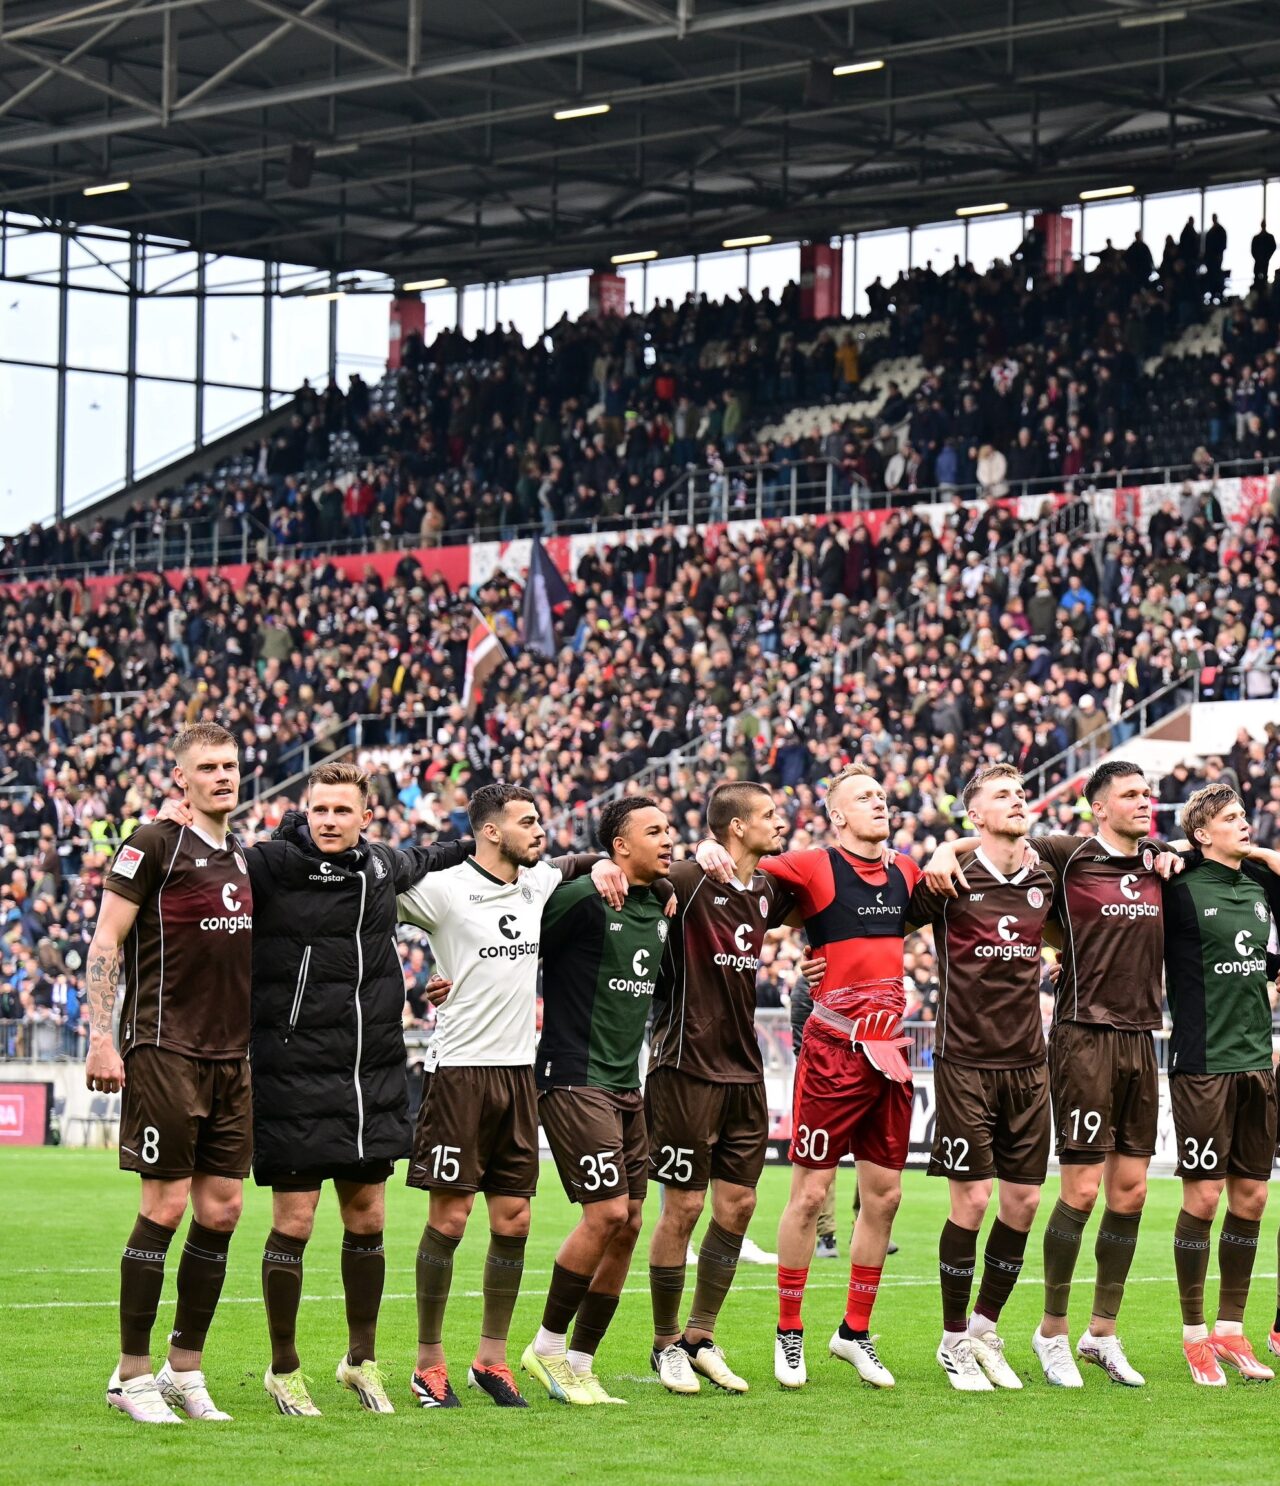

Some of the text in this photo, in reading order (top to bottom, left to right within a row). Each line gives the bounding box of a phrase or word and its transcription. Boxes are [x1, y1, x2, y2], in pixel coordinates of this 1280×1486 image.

[308, 873, 345, 883] congstar
[857, 905, 902, 917] CATAPULT
[1101, 902, 1160, 920] congstar
[478, 941, 539, 961] congstar
[974, 945, 1037, 961] congstar
[795, 1124, 830, 1162] 30
[1070, 1108, 1102, 1144] 19
[141, 1125, 160, 1165] 8
[942, 1136, 971, 1172] 32
[1182, 1137, 1219, 1171] 36
[431, 1144, 462, 1183] 15
[579, 1151, 620, 1192] 35
[660, 1145, 695, 1183] 25
